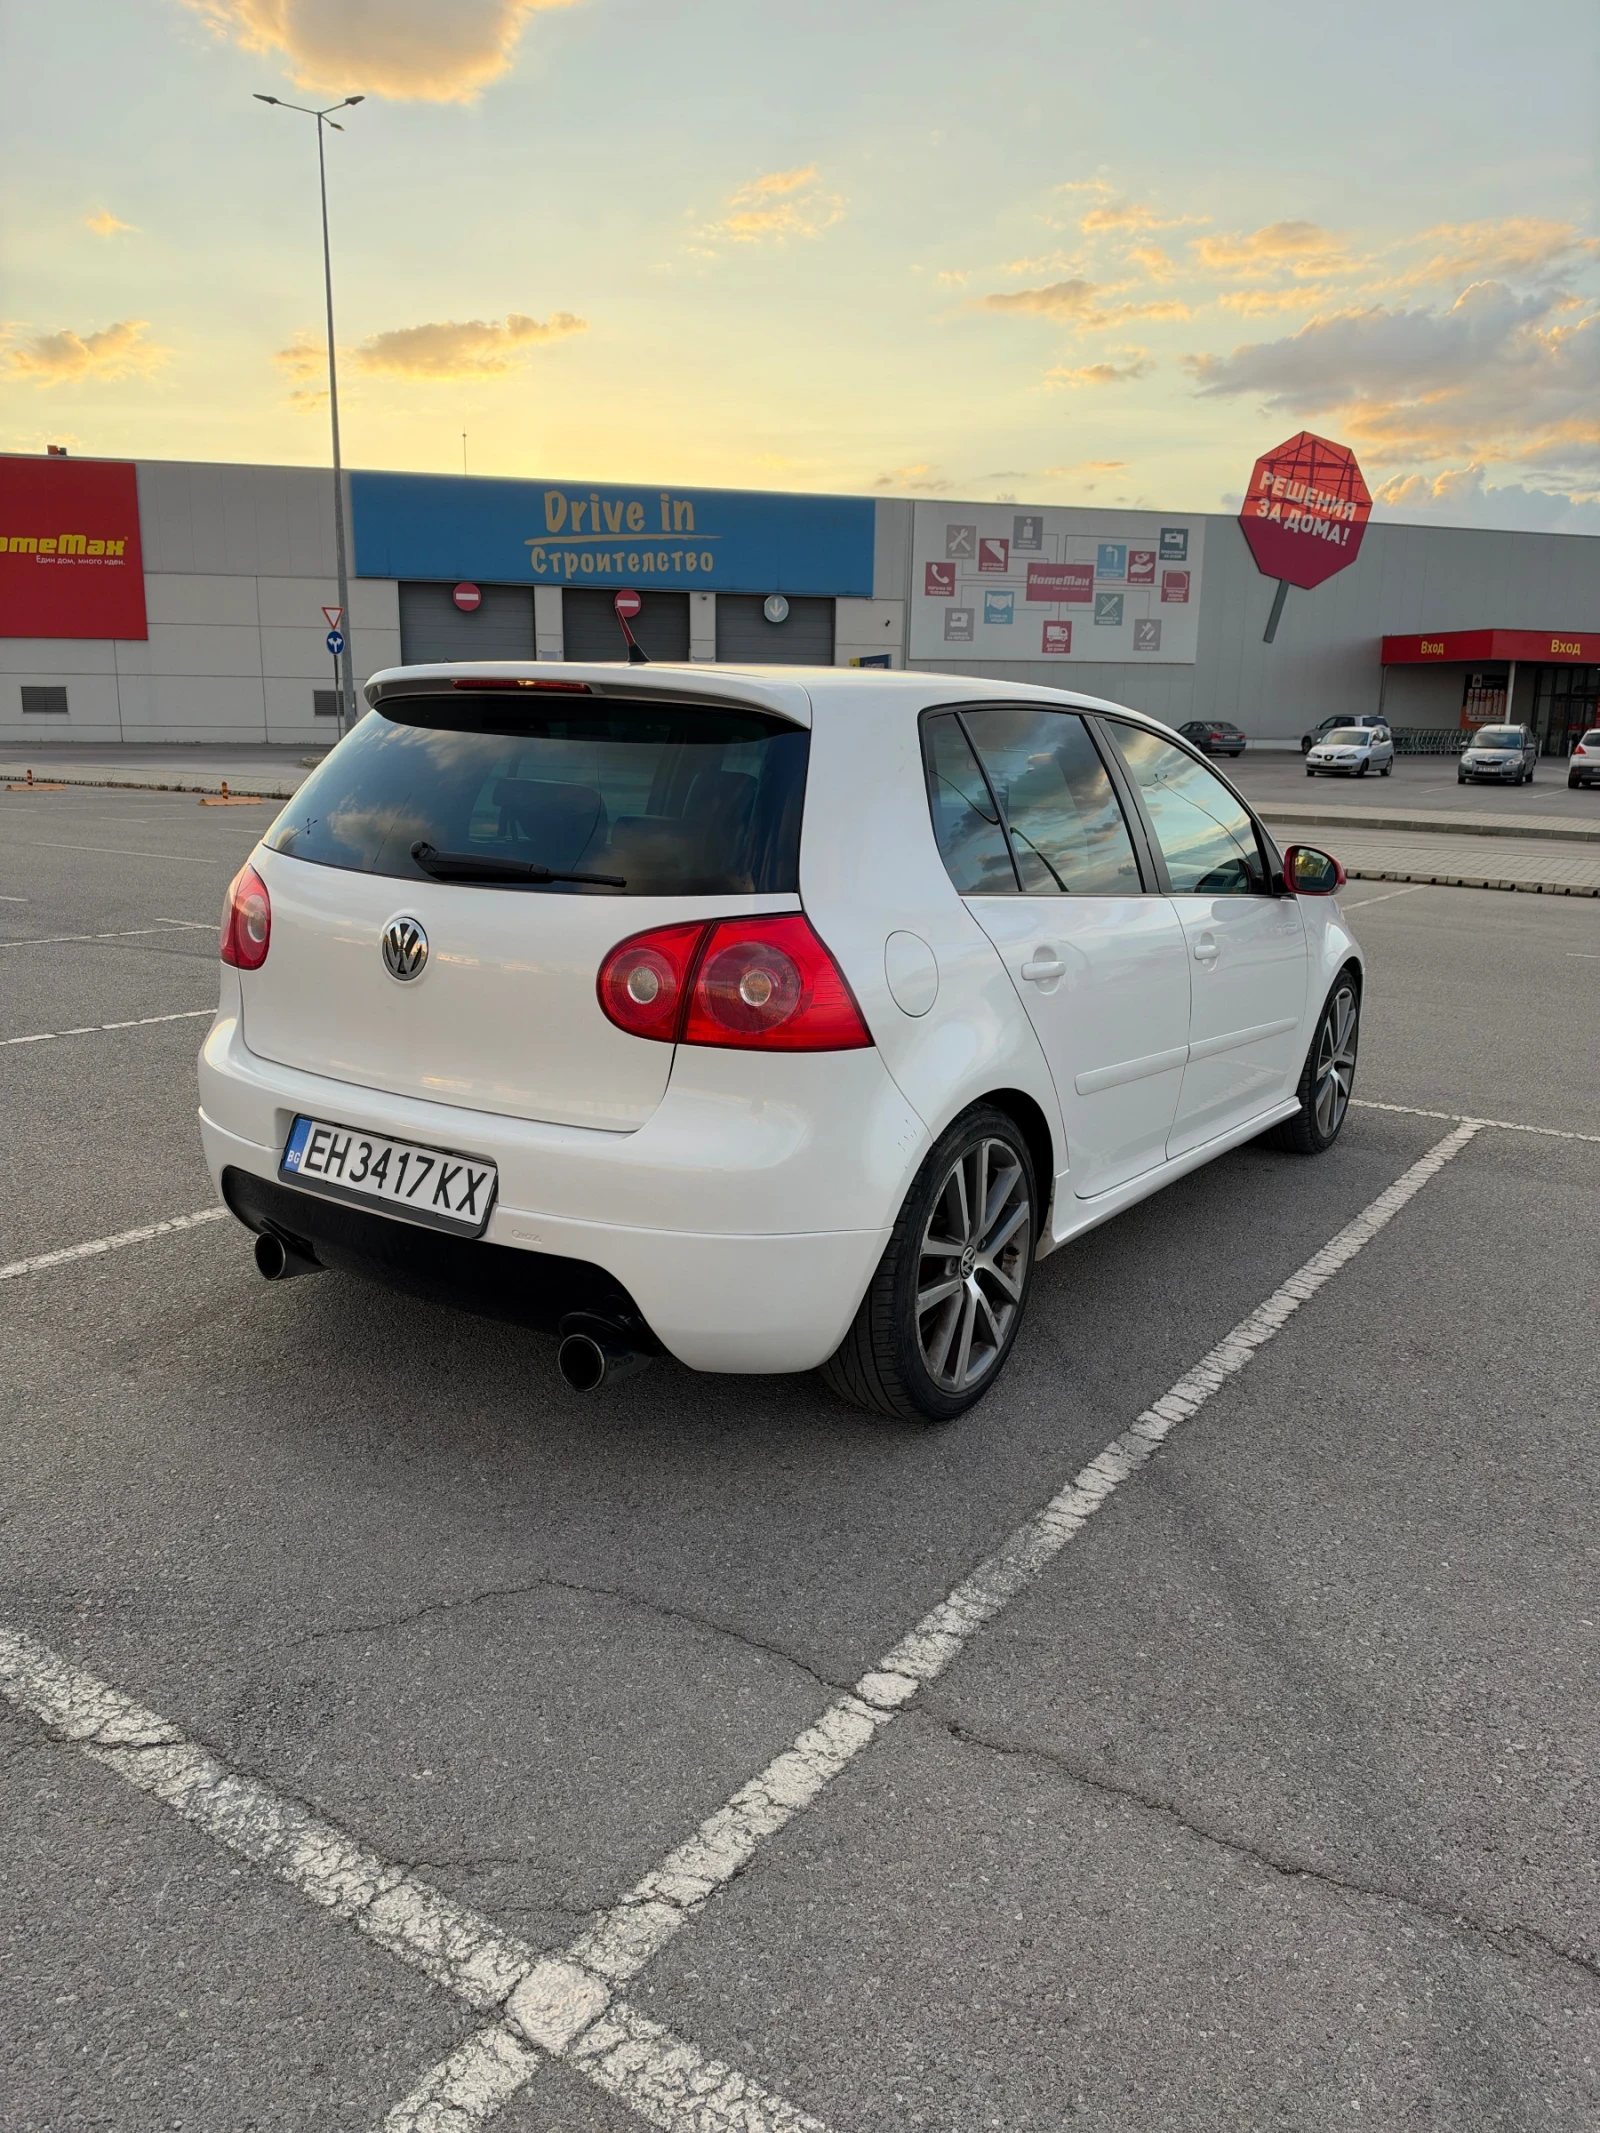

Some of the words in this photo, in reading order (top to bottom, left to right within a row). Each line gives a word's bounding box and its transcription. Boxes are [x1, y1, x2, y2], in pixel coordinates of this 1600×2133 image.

[1259, 471, 1357, 521] РЕШЕНИЯ
[544, 491, 645, 533] Drive
[660, 493, 695, 532] in
[1256, 498, 1281, 523] ЗА
[1283, 508, 1351, 546] ДОМА!
[36, 555, 56, 564] Един
[531, 547, 713, 579] Строителство
[1029, 574, 1090, 586] HomeMax
[1420, 641, 1444, 655] Вход
[1551, 639, 1581, 655] Вход
[287, 1150, 301, 1164] BG
